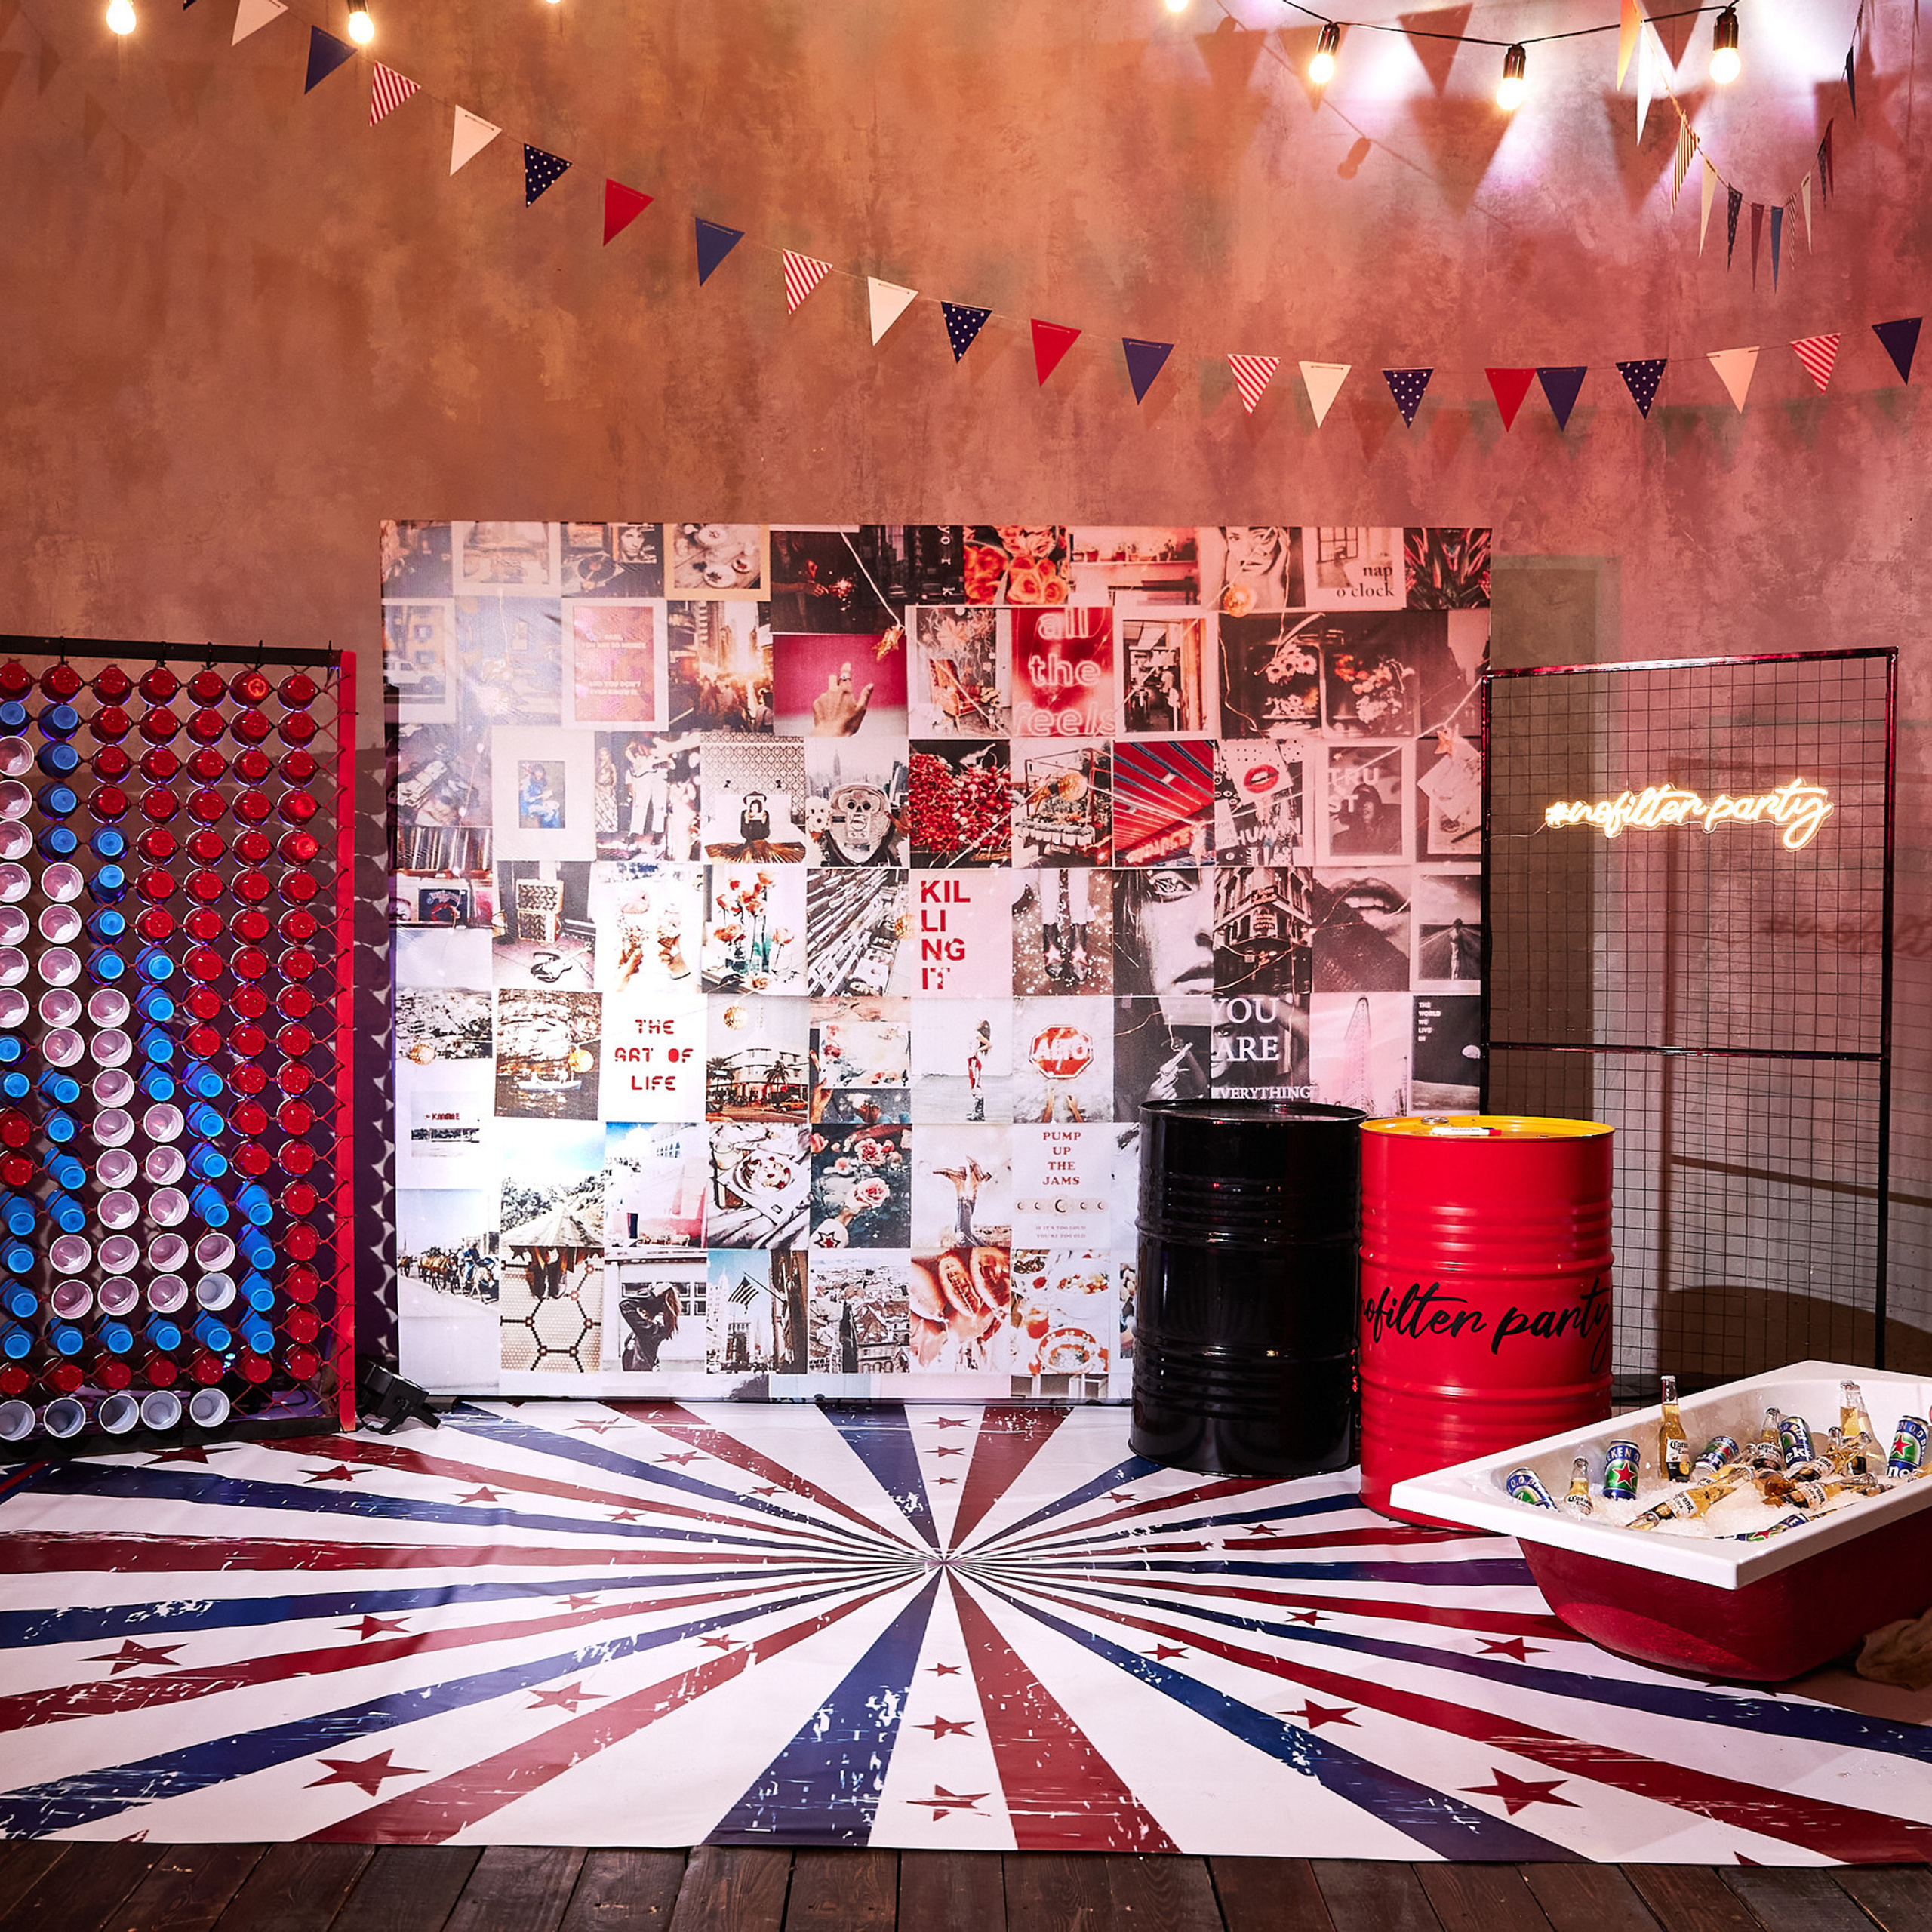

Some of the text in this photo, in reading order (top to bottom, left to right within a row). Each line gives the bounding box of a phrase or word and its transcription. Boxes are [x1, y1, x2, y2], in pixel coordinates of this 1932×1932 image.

[1363, 567, 1392, 581] nap
[1038, 607, 1088, 640] all
[1028, 653, 1101, 687] the
[1014, 701, 1115, 737] feels
[1708, 778, 1833, 851] party
[921, 880, 971, 903] KIL
[921, 909, 946, 932] LI
[921, 938, 965, 961] NG
[922, 968, 950, 989] IT
[1211, 998, 1279, 1023] YOU
[635, 1019, 675, 1035] THE
[614, 1047, 694, 1063] ART OF
[1211, 1036, 1279, 1061] ARE
[632, 1075, 676, 1091] LIFE
[1043, 1132, 1081, 1140] PUMP
[1052, 1146, 1071, 1155] UP
[1048, 1161, 1075, 1171] THE
[1042, 1176, 1080, 1186] JAMS
